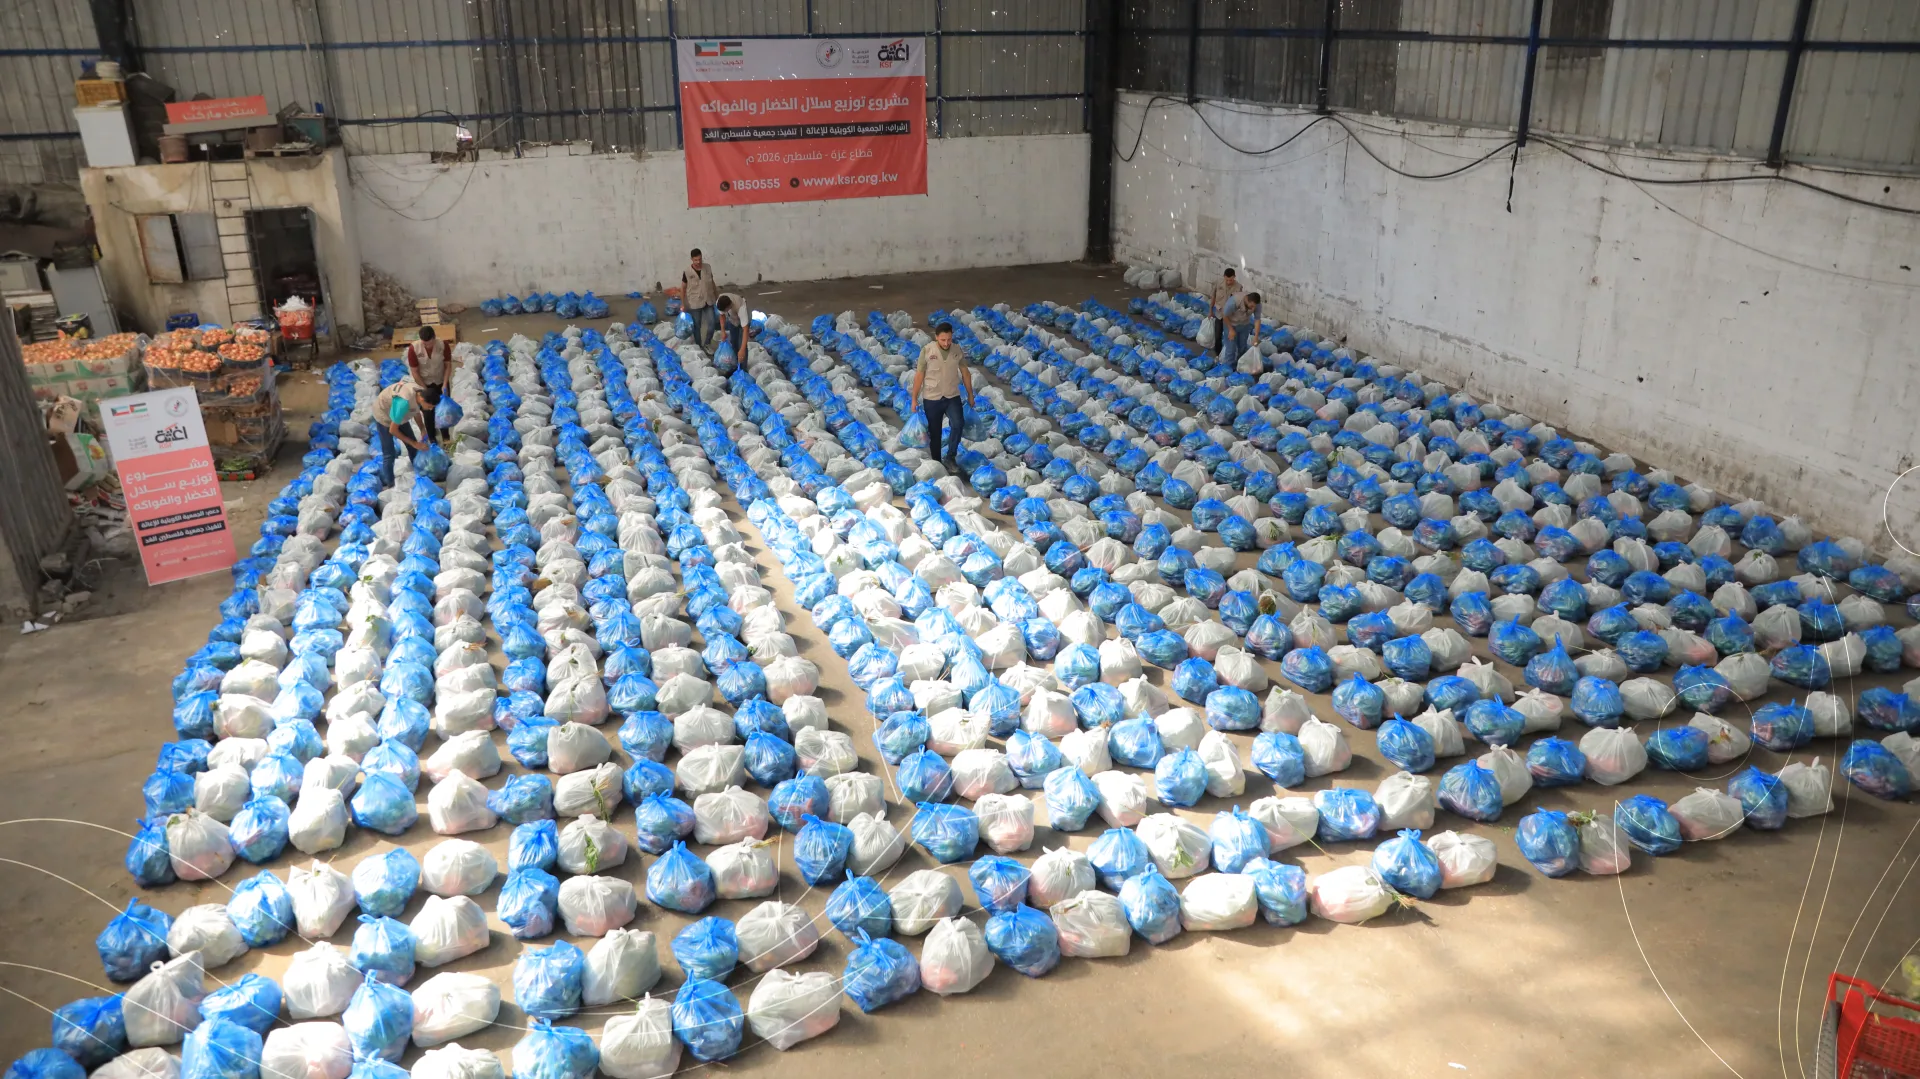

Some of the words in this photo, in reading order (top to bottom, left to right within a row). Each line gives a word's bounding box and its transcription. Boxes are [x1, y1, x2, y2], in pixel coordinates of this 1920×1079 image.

[760, 97, 798, 114] الخضار
[800, 96, 832, 112] سلال
[834, 96, 866, 111] توزيع
[868, 93, 910, 110] مشروع
[700, 99, 757, 116] والفواكه
[752, 129, 776, 138] جمعية
[778, 128, 797, 136] تنفيذ:
[806, 126, 828, 136] للإغاثة
[830, 126, 856, 135] الكويتية
[856, 125, 884, 134] الجمعية
[886, 123, 908, 133] إشراف:
[704, 130, 720, 139] الغد
[721, 129, 751, 140] فلسطين
[757, 152, 781, 162] 2026
[783, 150, 823, 163] فلسطين
[831, 150, 847, 162] غزة
[849, 149, 873, 160] قطاع
[745, 155, 754, 166] م
[732, 178, 780, 190] 1850555
[802, 173, 898, 187] www.ksr.org.kw
[178, 473, 212, 490] توزيع
[129, 480, 176, 498] سلال
[184, 488, 217, 503] الخضار
[133, 495, 182, 511] والفواكه
[183, 511, 204, 520] الجمعية
[158, 531, 184, 542] فلسطين
[185, 527, 204, 536] جمعية
